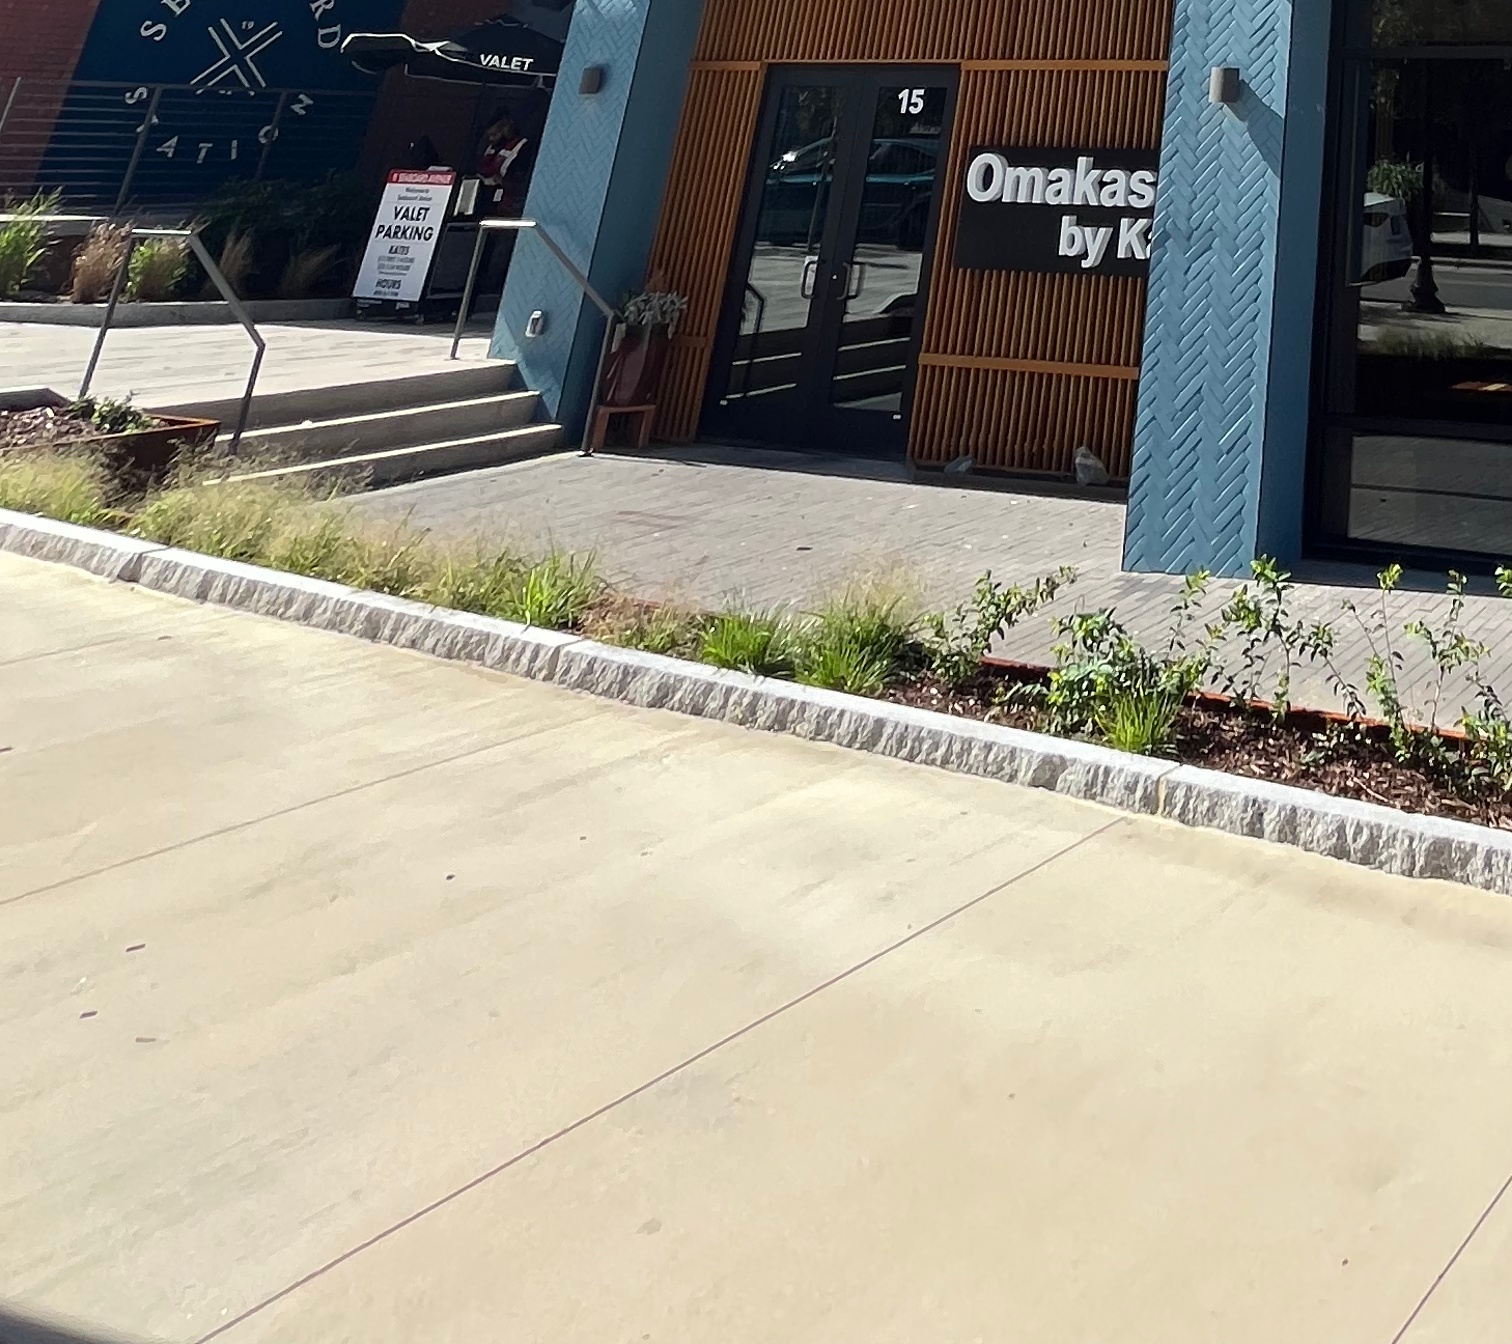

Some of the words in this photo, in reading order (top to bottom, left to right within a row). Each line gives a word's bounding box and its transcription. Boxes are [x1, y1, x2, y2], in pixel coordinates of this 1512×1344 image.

[479, 53, 535, 72] VALET
[898, 88, 925, 114] 15
[966, 152, 1158, 208] Omakas
[394, 206, 430, 221] VALET
[375, 225, 433, 241] PARKING
[1058, 215, 1113, 269] by
